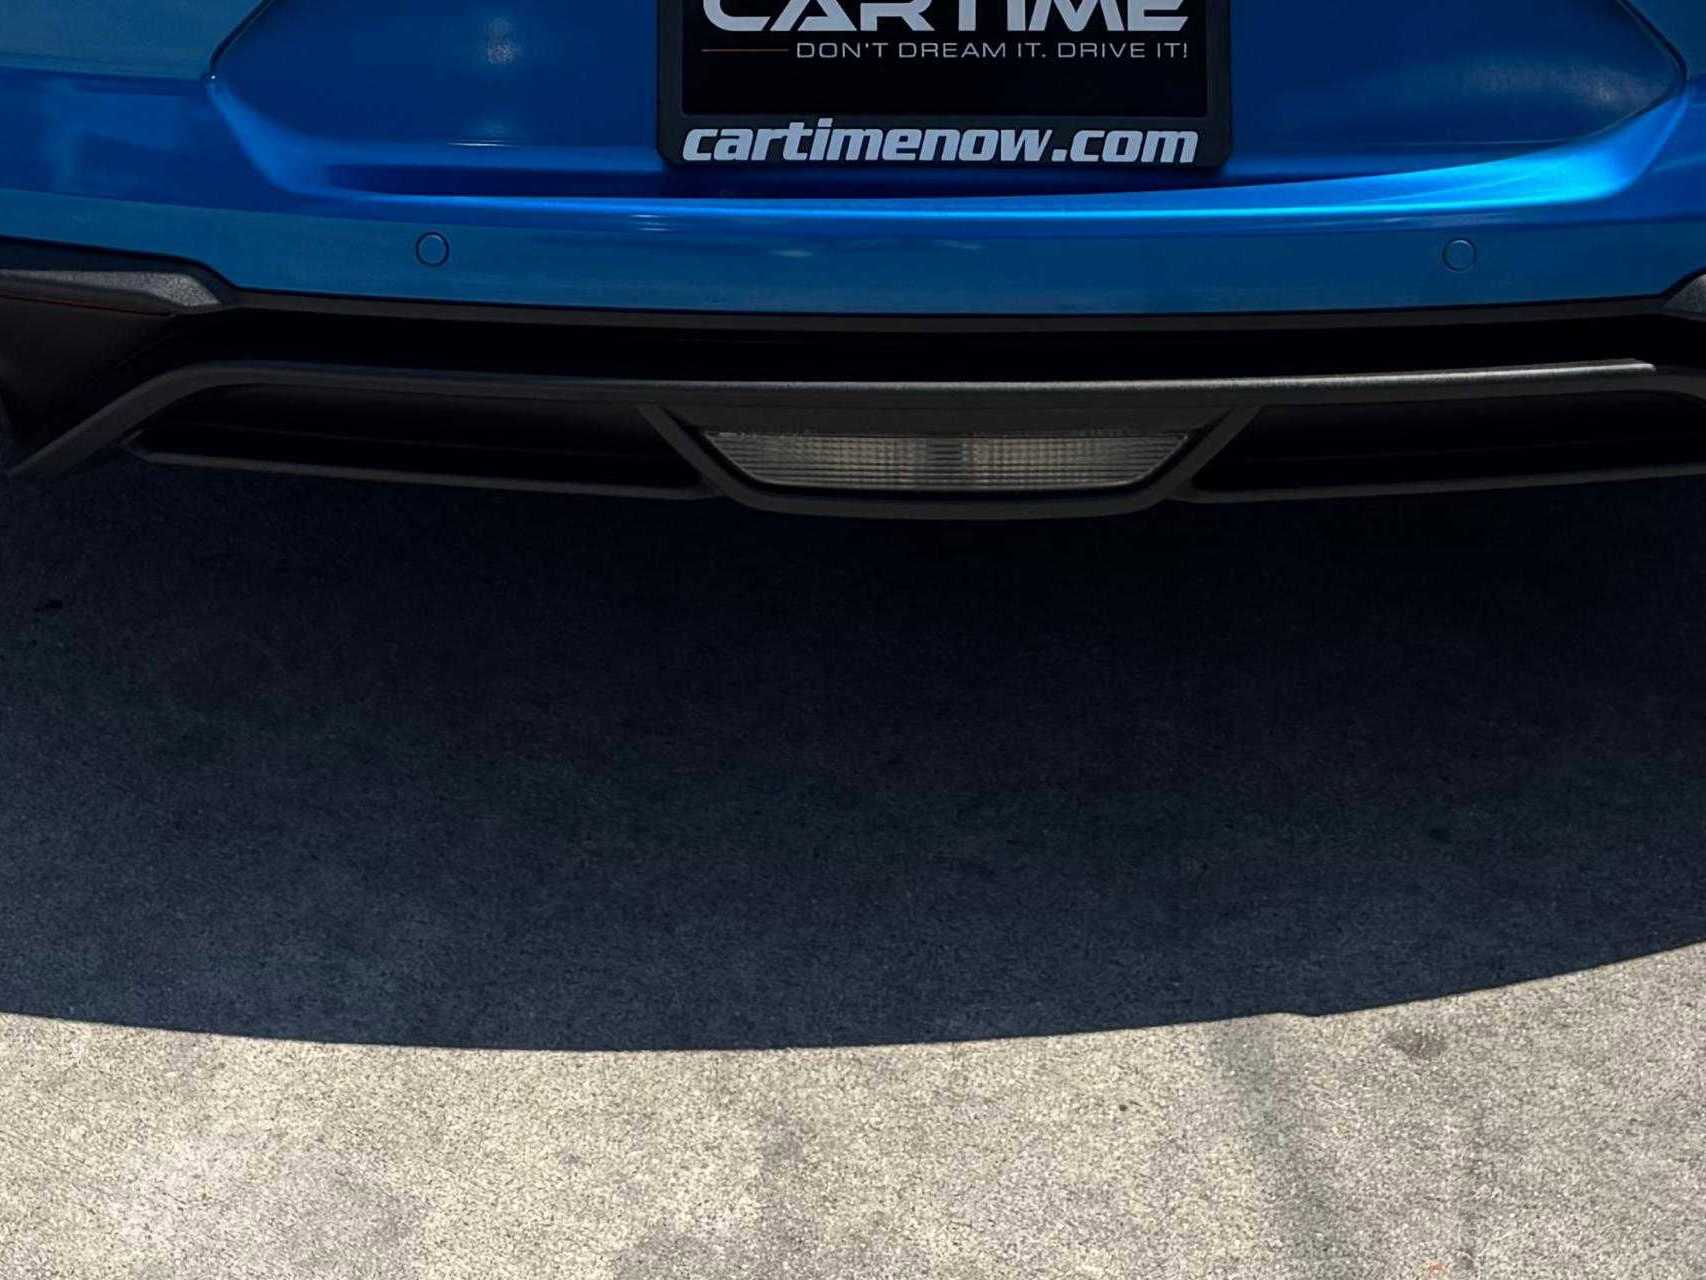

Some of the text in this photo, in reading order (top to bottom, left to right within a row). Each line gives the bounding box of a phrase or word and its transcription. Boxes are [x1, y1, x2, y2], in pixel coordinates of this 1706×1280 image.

[796, 41, 1189, 59] DON'T DREAM IT. DRIVE IT!
[682, 117, 1198, 164] cartimenow.com
